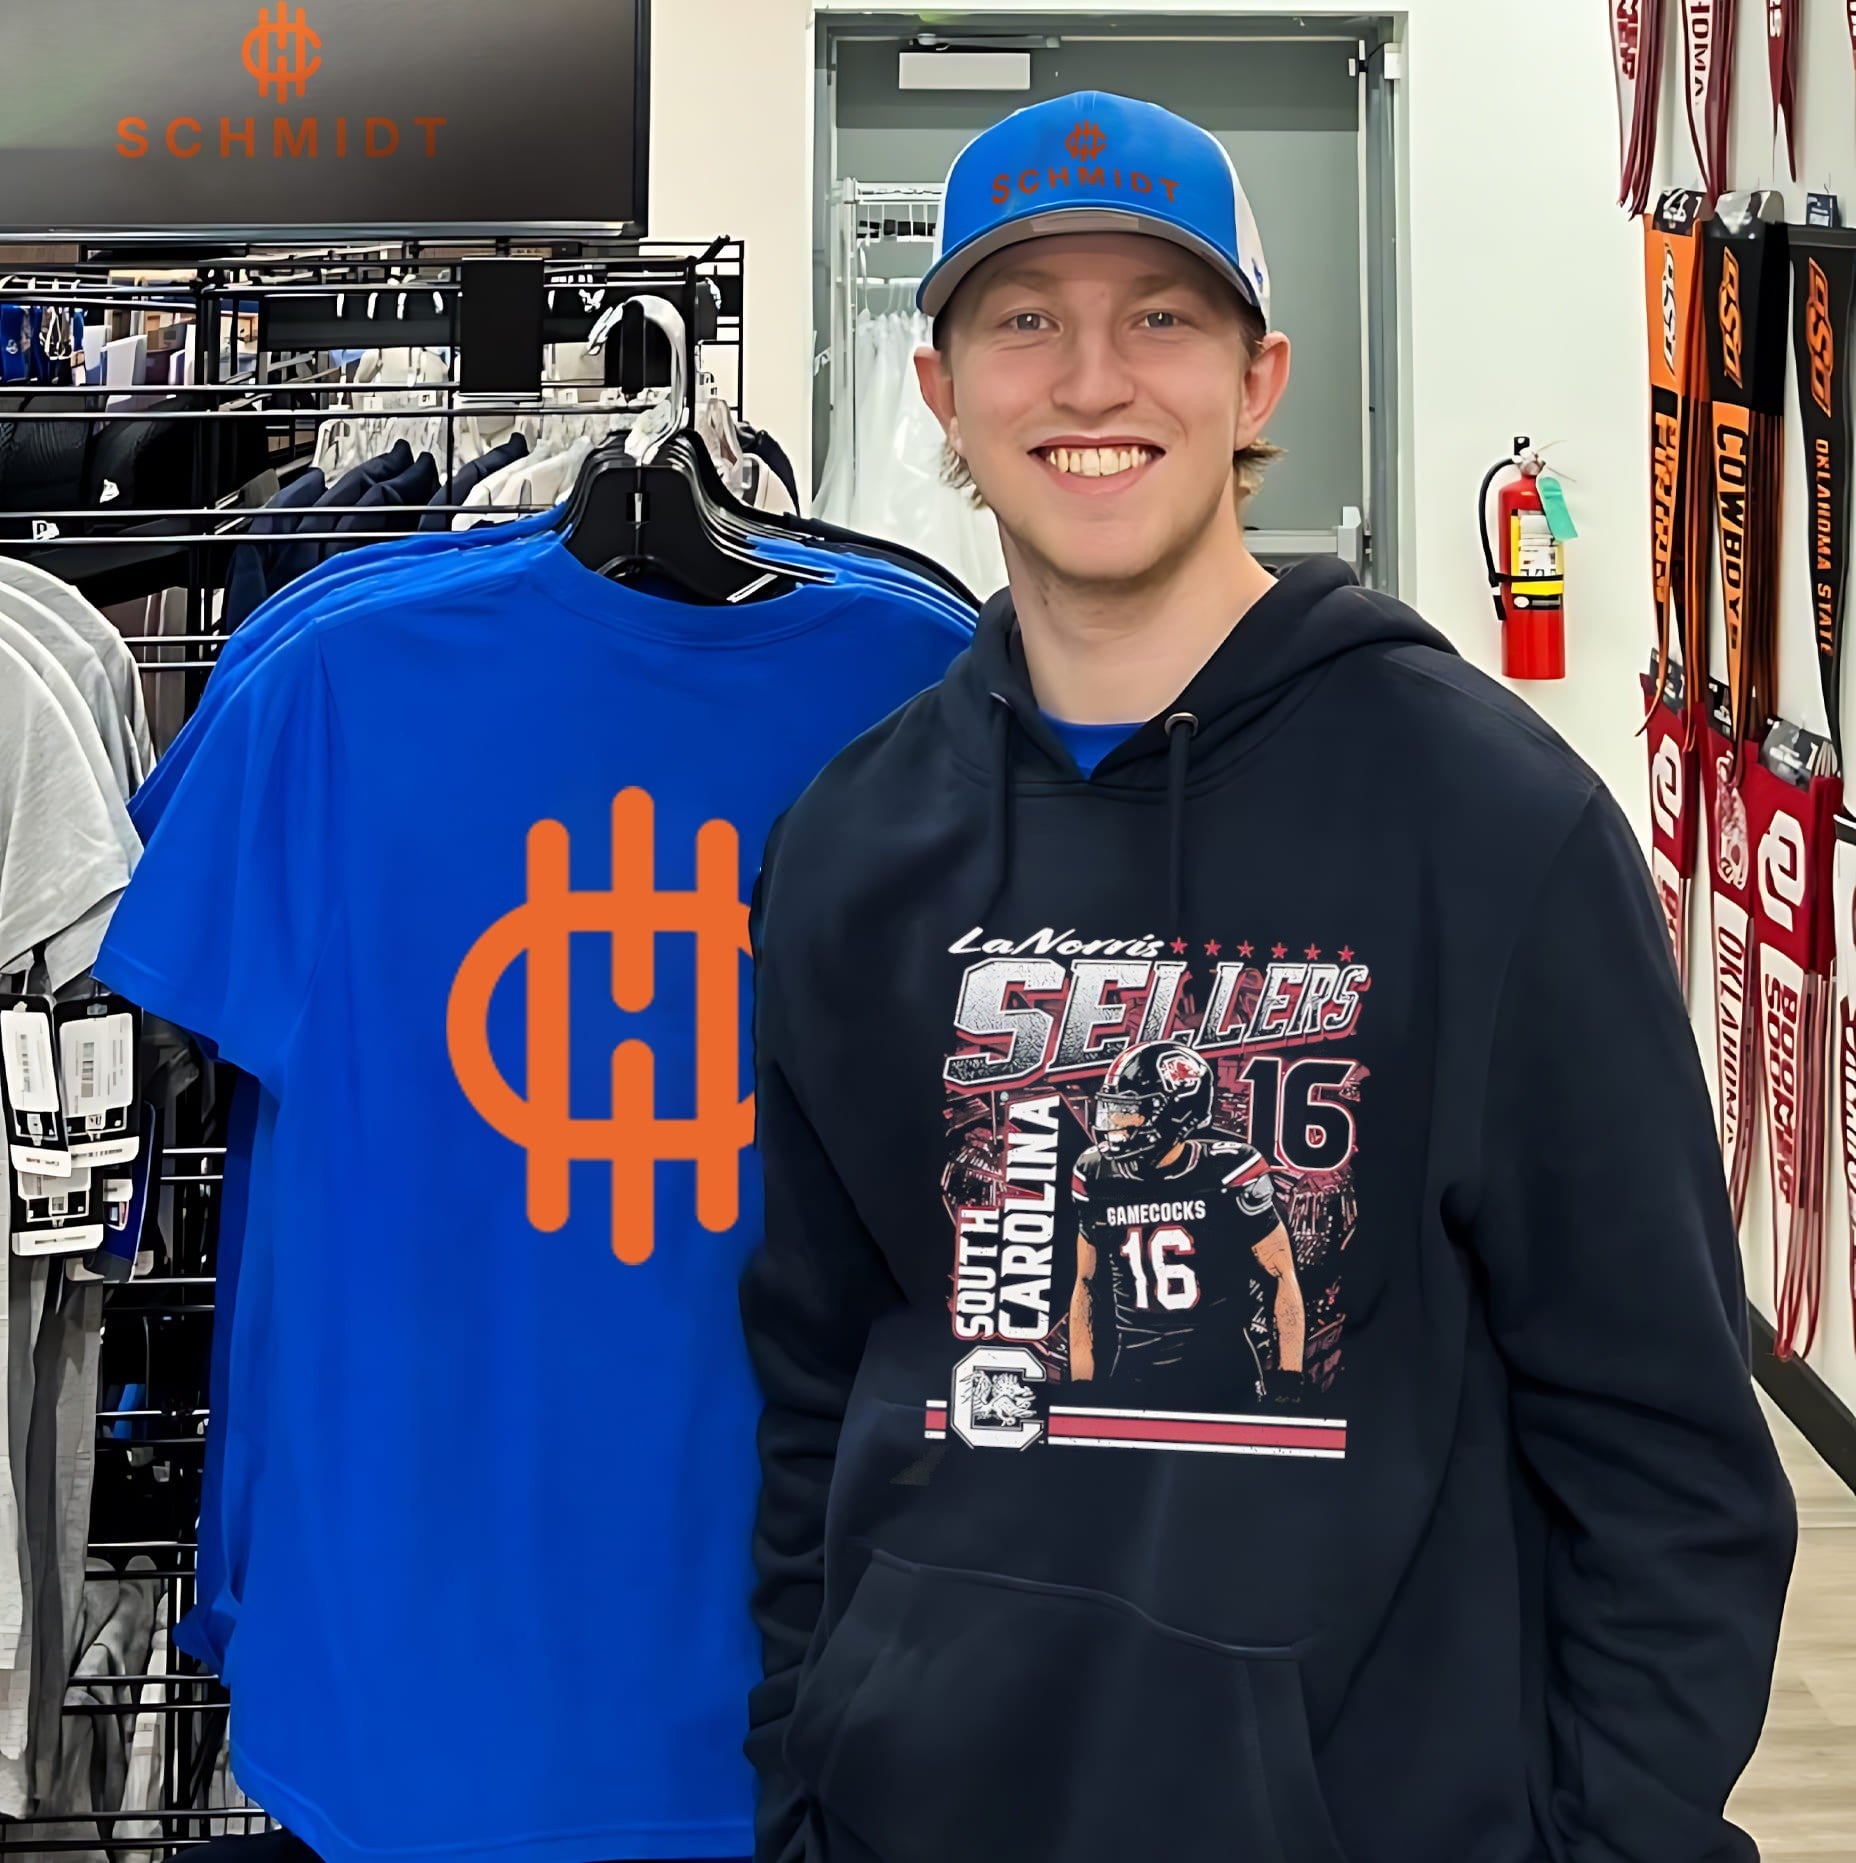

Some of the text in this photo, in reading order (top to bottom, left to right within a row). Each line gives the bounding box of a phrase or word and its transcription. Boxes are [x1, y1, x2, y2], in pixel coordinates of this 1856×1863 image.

[116, 116, 448, 159] SCHMIDT
[991, 167, 1180, 205] SCHMIDT
[1815, 438, 1832, 571] OKLAHOMA
[948, 926, 1165, 959] LaNorris
[942, 957, 1371, 1086] SELLERS
[1718, 926, 1745, 1144] OKLAHOMA
[1239, 1055, 1359, 1172] 16
[1000, 1097, 1060, 1340] CAROLINA
[1107, 1200, 1206, 1226] GAMECOCKS
[1121, 1228, 1199, 1311] 16
[955, 1208, 1000, 1340] SOUTH
